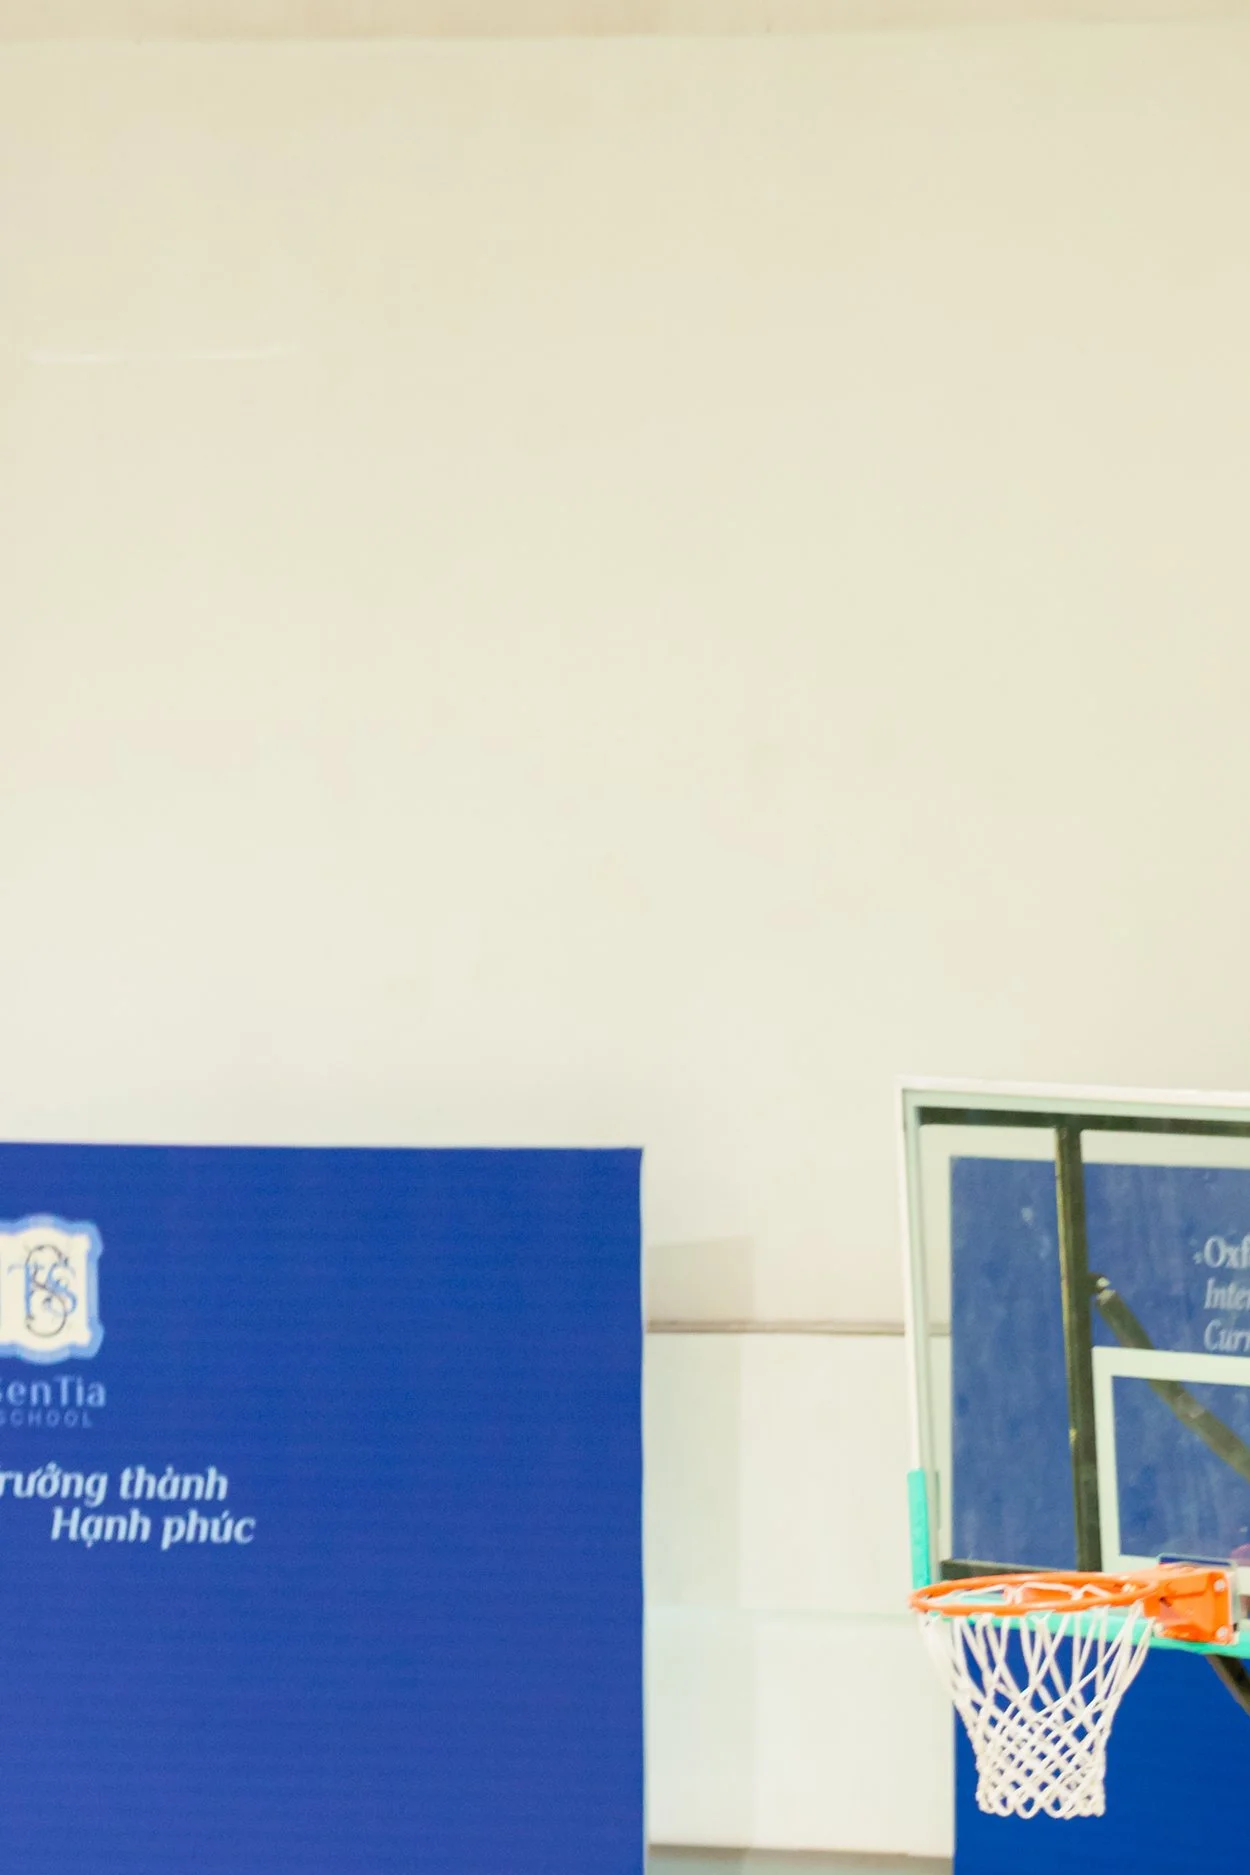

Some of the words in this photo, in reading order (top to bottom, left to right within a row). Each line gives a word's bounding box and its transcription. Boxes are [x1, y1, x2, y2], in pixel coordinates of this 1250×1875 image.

[0, 1374, 106, 1407] enTia
[0, 1461, 108, 1508] rưởng
[51, 1505, 151, 1548] Hạnh
[161, 1509, 256, 1551] phúc
